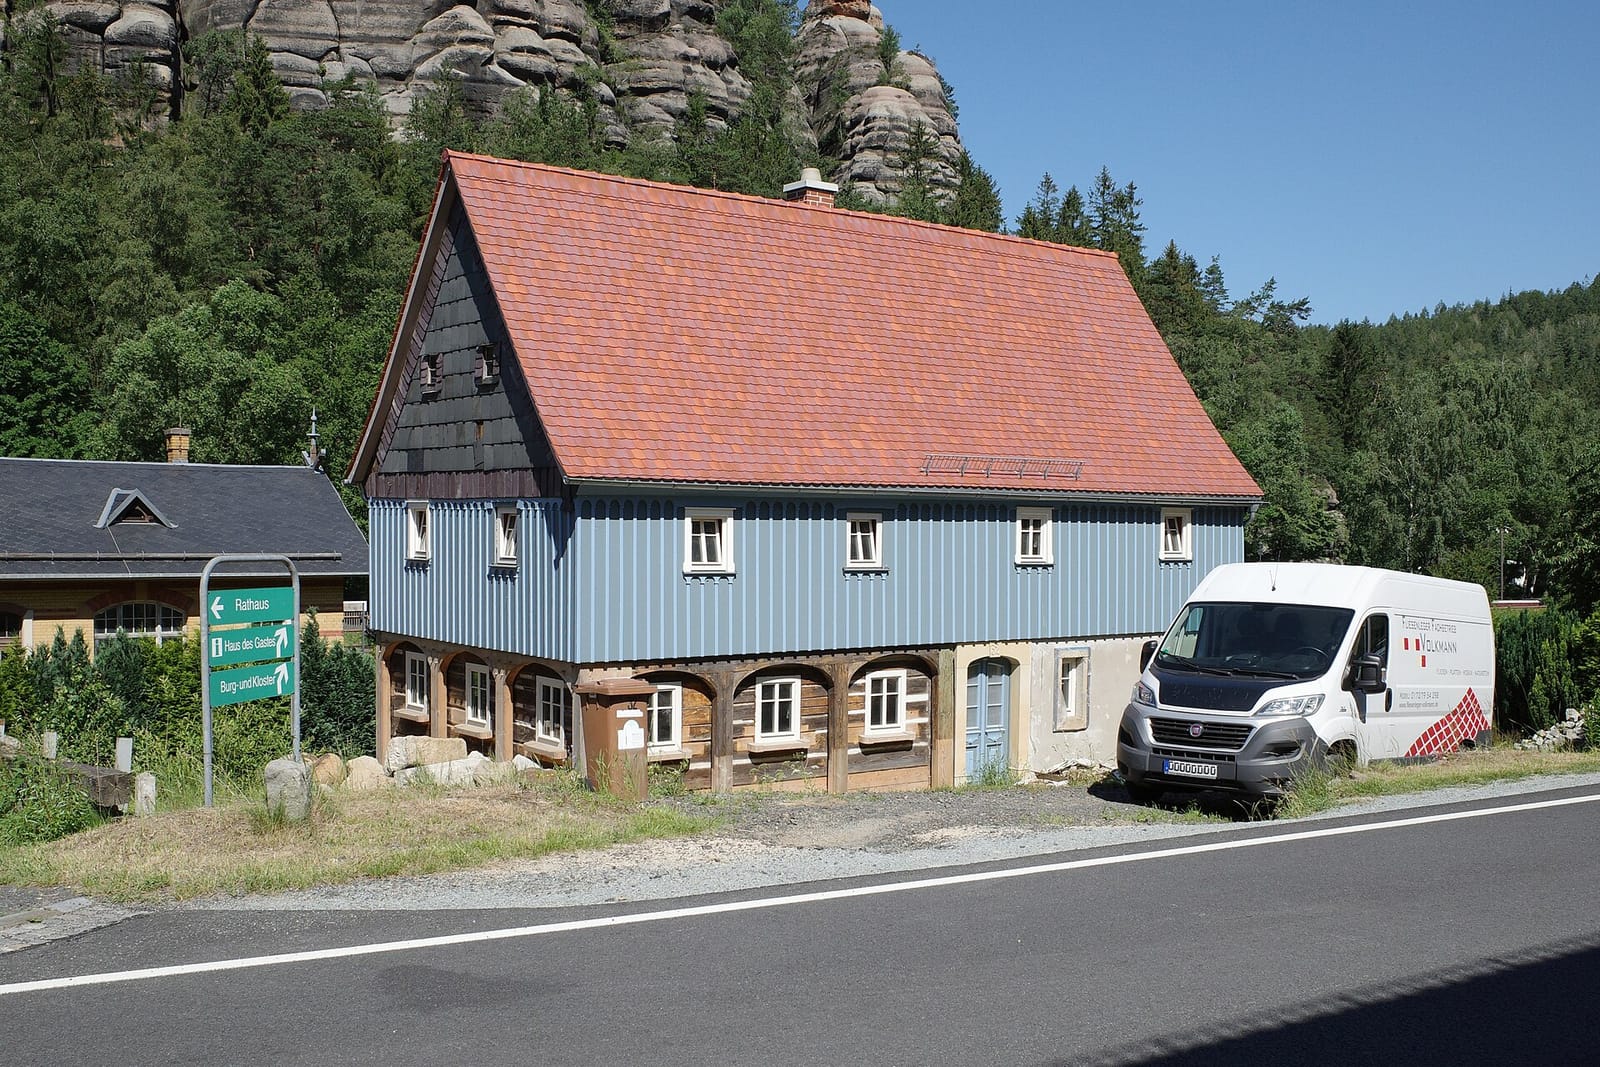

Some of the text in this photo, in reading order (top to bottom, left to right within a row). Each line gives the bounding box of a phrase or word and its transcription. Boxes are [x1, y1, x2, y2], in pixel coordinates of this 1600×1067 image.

[235, 598, 270, 611] Rathaus
[224, 640, 241, 652] Haus
[242, 638, 253, 650] des
[254, 636, 276, 649] Gastes
[252, 675, 276, 686] Kloster
